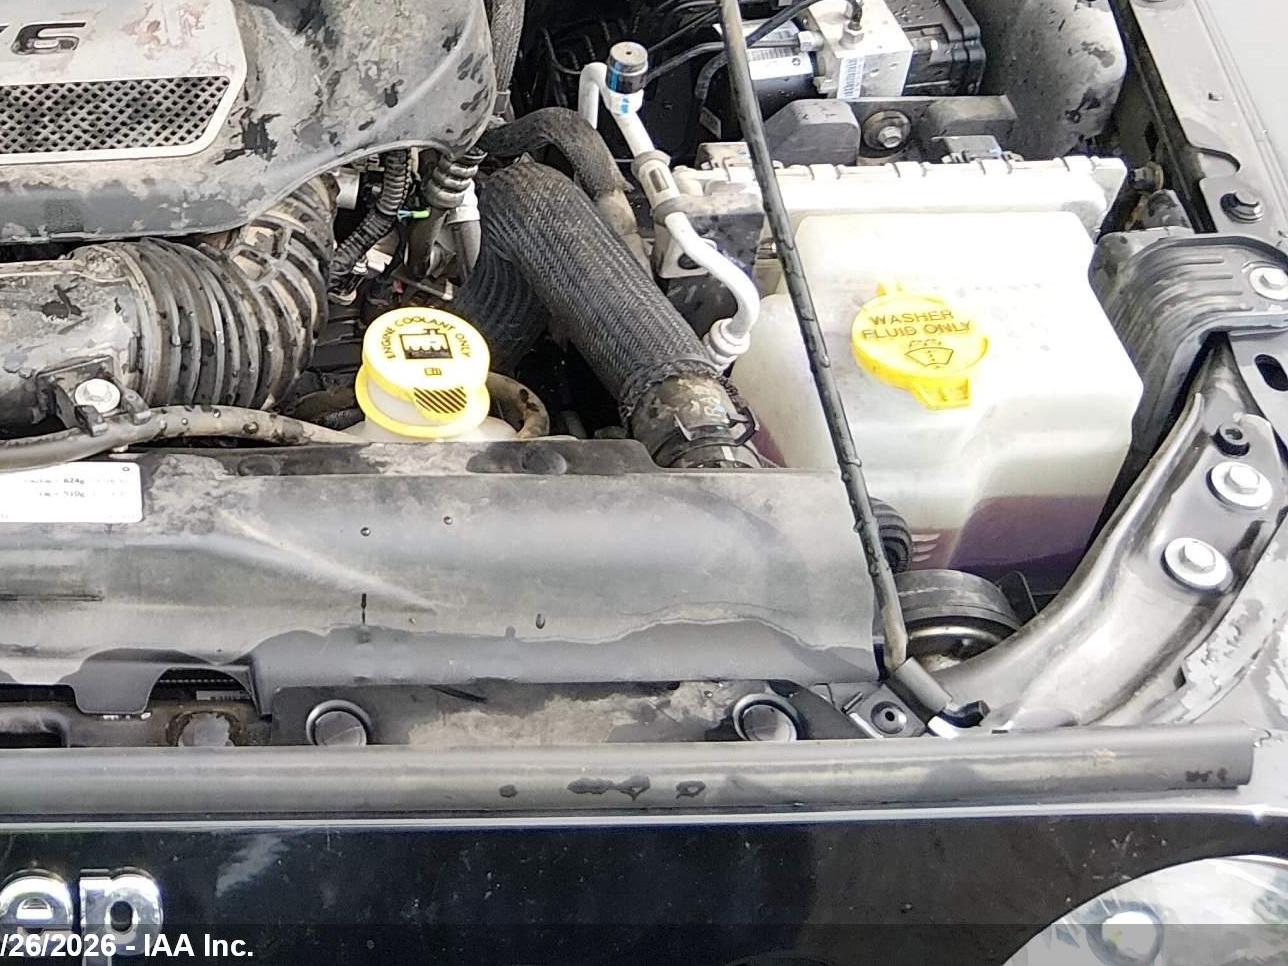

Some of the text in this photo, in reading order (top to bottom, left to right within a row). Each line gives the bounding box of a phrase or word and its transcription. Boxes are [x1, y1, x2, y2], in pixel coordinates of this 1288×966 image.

[870, 310, 954, 325] WASHER
[380, 315, 471, 360] ENGINE COOLANT ONLY
[862, 320, 972, 340] FLUID ONLY
